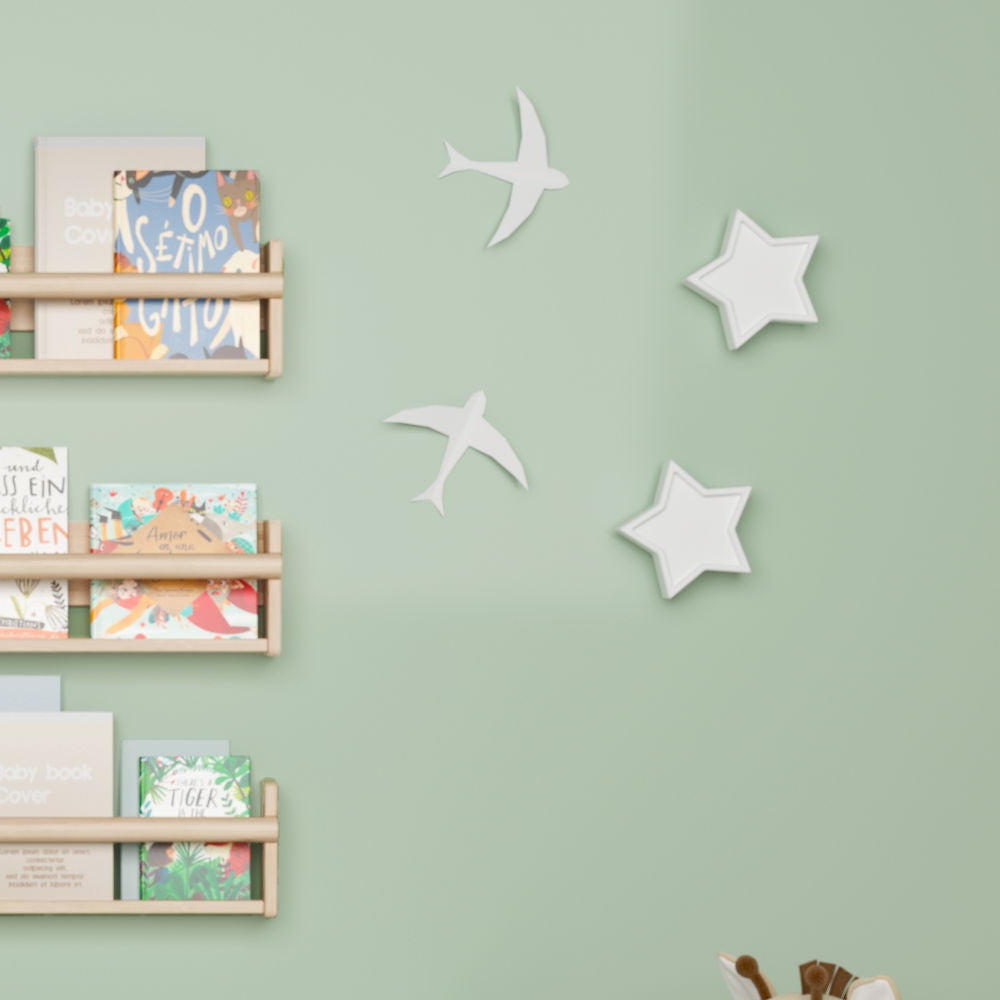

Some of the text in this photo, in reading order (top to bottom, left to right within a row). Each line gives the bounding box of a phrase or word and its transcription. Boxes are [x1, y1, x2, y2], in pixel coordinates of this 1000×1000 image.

[64, 197, 112, 219] Baby
[182, 183, 207, 233] O
[64, 225, 112, 245] Cov
[4, 459, 43, 472] und
[29, 476, 65, 497] EIN
[45, 764, 94, 781] book
[168, 788, 218, 807] TIGER
